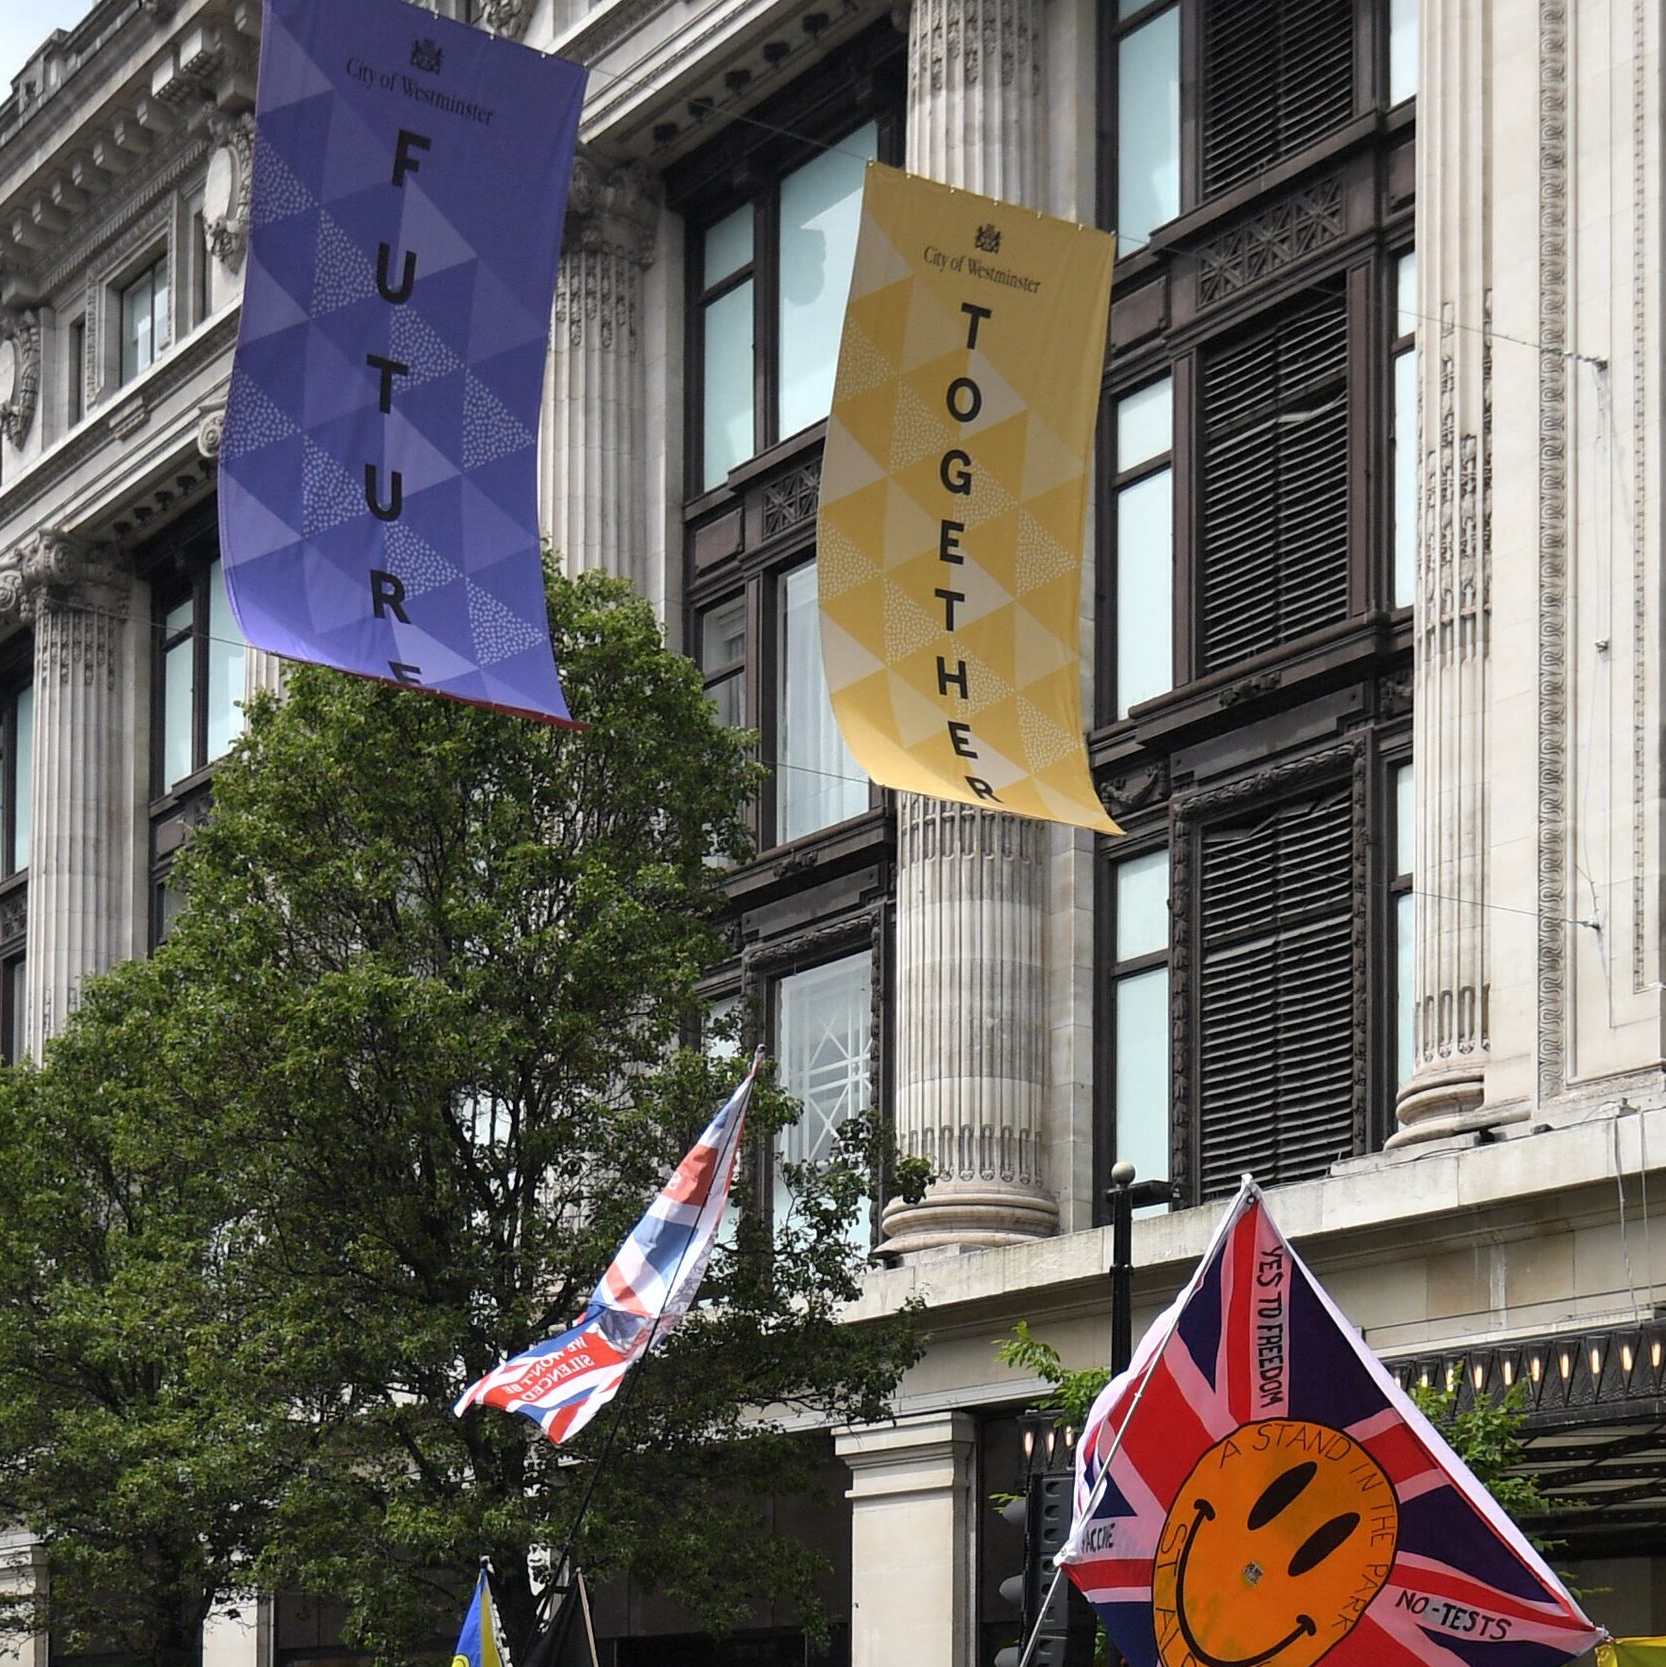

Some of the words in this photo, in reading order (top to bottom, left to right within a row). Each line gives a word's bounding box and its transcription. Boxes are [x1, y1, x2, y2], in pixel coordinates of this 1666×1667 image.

[346, 57, 376, 89] City
[380, 72, 398, 91] of
[402, 75, 494, 126] Westminster
[923, 246, 947, 272] City
[950, 256, 966, 273] of
[968, 257, 1041, 294] Westminster
[934, 301, 1006, 805] TOGETHER
[1257, 1246, 1283, 1287] YES
[1257, 1292, 1282, 1326] TO
[1257, 1325, 1287, 1408] FREEDOM
[1218, 1439, 1241, 1470] A
[1252, 1423, 1352, 1463] STAND
[1351, 1462, 1383, 1494] IN
[1368, 1497, 1396, 1549] THE
[1159, 1521, 1188, 1583] ST
[1331, 1562, 1388, 1633] PARK
